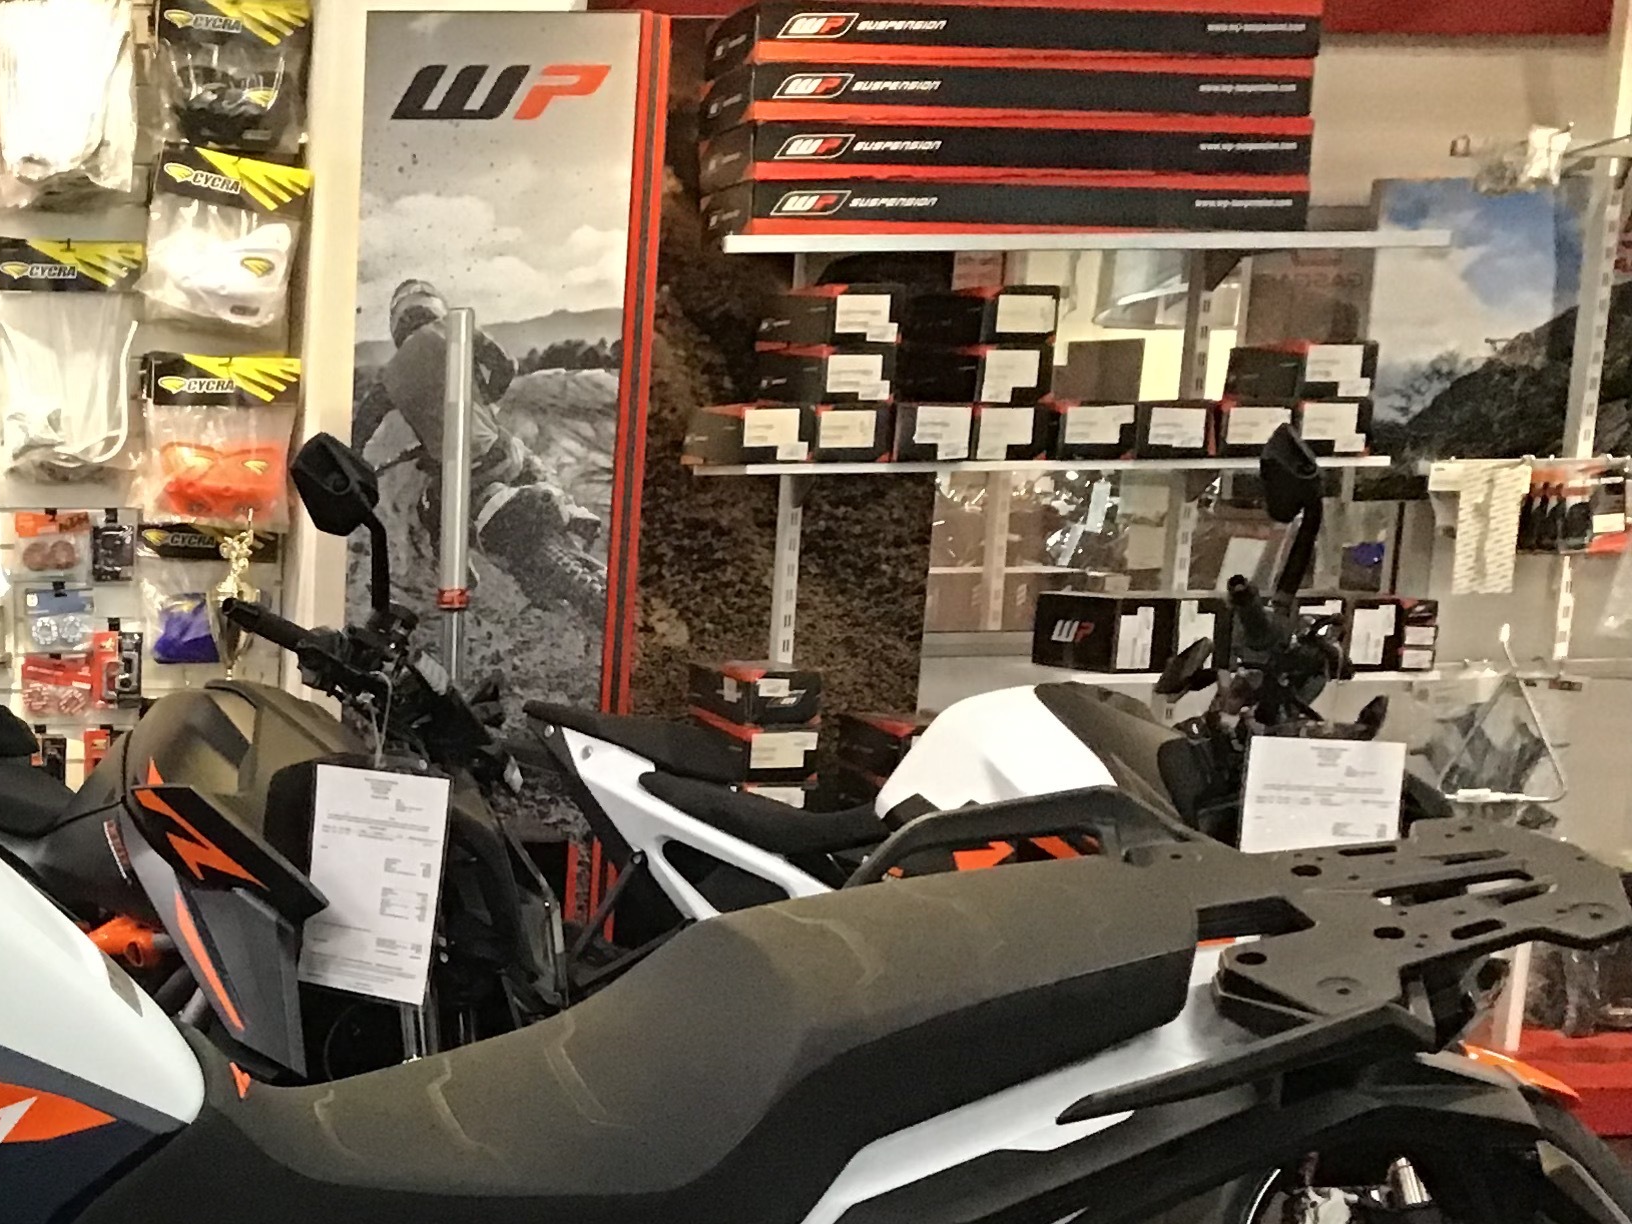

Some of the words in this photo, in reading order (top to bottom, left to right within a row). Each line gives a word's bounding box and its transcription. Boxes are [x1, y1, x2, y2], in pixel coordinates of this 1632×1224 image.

[192, 14, 242, 33] CYCRA
[787, 17, 847, 34] WP
[856, 20, 948, 31] SUSPENSION
[391, 64, 611, 120] WP
[784, 78, 841, 95] WP
[852, 80, 942, 91] SUSPENSION
[785, 138, 844, 155] WP
[853, 140, 943, 151] SUSPENSION
[191, 170, 242, 194] CYCRA
[781, 195, 839, 211] WP
[849, 197, 938, 208] SUSPENSION
[28, 264, 77, 279] CYCRA
[186, 378, 235, 393] CYCRA
[169, 532, 216, 548] CYCRA
[1051, 619, 1095, 643] WP
